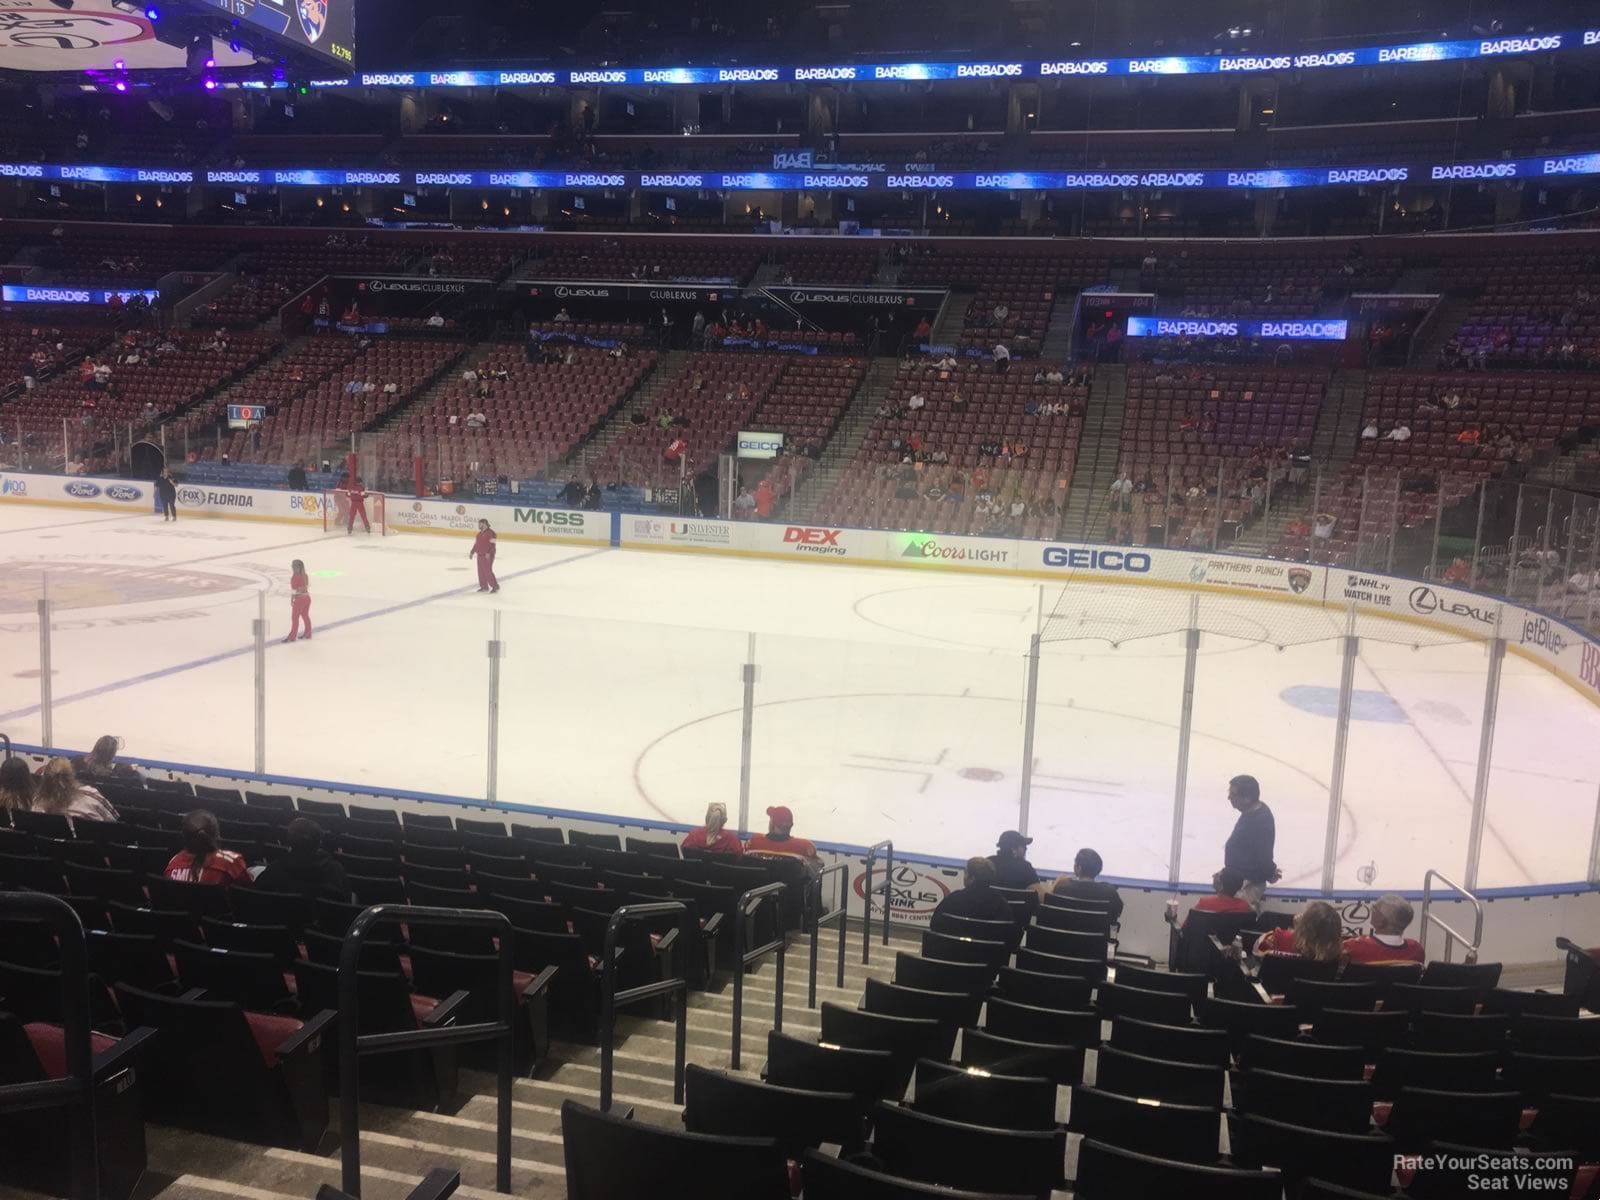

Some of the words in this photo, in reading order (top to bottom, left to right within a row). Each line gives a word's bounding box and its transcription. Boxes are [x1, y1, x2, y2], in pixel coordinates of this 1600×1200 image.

[236, 2, 245, 15] 13
[1480, 35, 1561, 54] BARBADOS
[362, 74, 414, 85] BARBADOS
[500, 73, 555, 83] BARBADOS
[570, 71, 626, 82] BARBADOS
[719, 69, 778, 80] BARBADOS
[795, 67, 856, 79] BARBADOS
[957, 64, 1022, 76] BARBADOS
[1040, 61, 1108, 74] BARBADOS
[1219, 56, 1291, 70] BARBADOS
[138, 171, 193, 182] BARBADOS
[207, 172, 260, 183] BARBADOS
[346, 173, 400, 183] BARBADOS
[415, 173, 472, 185] BARBADOS
[566, 175, 625, 186] BARBADOS
[641, 175, 702, 187] BARBADOS
[804, 175, 868, 187] BARBADOS
[887, 175, 953, 188] BARBADOS
[1066, 174, 1138, 187] BARBADOS
[1328, 168, 1408, 183] BARBADOS
[1431, 163, 1516, 180] BARBADOS
[26, 289, 90, 302] BARBADOS
[568, 289, 609, 297] LEXUS
[650, 290, 697, 300] CLUBLEXUS
[805, 295, 849, 303] LEXUS
[852, 295, 903, 305] CLUBLEXUS
[1157, 321, 1238, 336] BARBADOS
[739, 441, 781, 451] GEICO
[70, 484, 96, 496] Ford
[111, 487, 136, 499] Ford
[182, 490, 200, 500] FOX
[207, 492, 253, 507] FLORIDA
[407, 518, 431, 526] CASINO
[514, 508, 584, 526] MOSS
[449, 521, 474, 529] CASINO
[547, 526, 584, 535] CONSTRUCTION
[688, 524, 730, 536] SYLVESTER
[783, 527, 842, 546] DEX
[796, 544, 847, 556] imaging
[920, 541, 966, 560] Coors
[968, 549, 1008, 562] LIGHT
[1043, 547, 1151, 573] GEICO
[1208, 560, 1252, 573] PANTHERS
[1255, 565, 1284, 577] PUNCH
[1344, 588, 1373, 603] WATCH
[1374, 593, 1391, 606] LIVE
[1520, 612, 1561, 655] jetBlue
